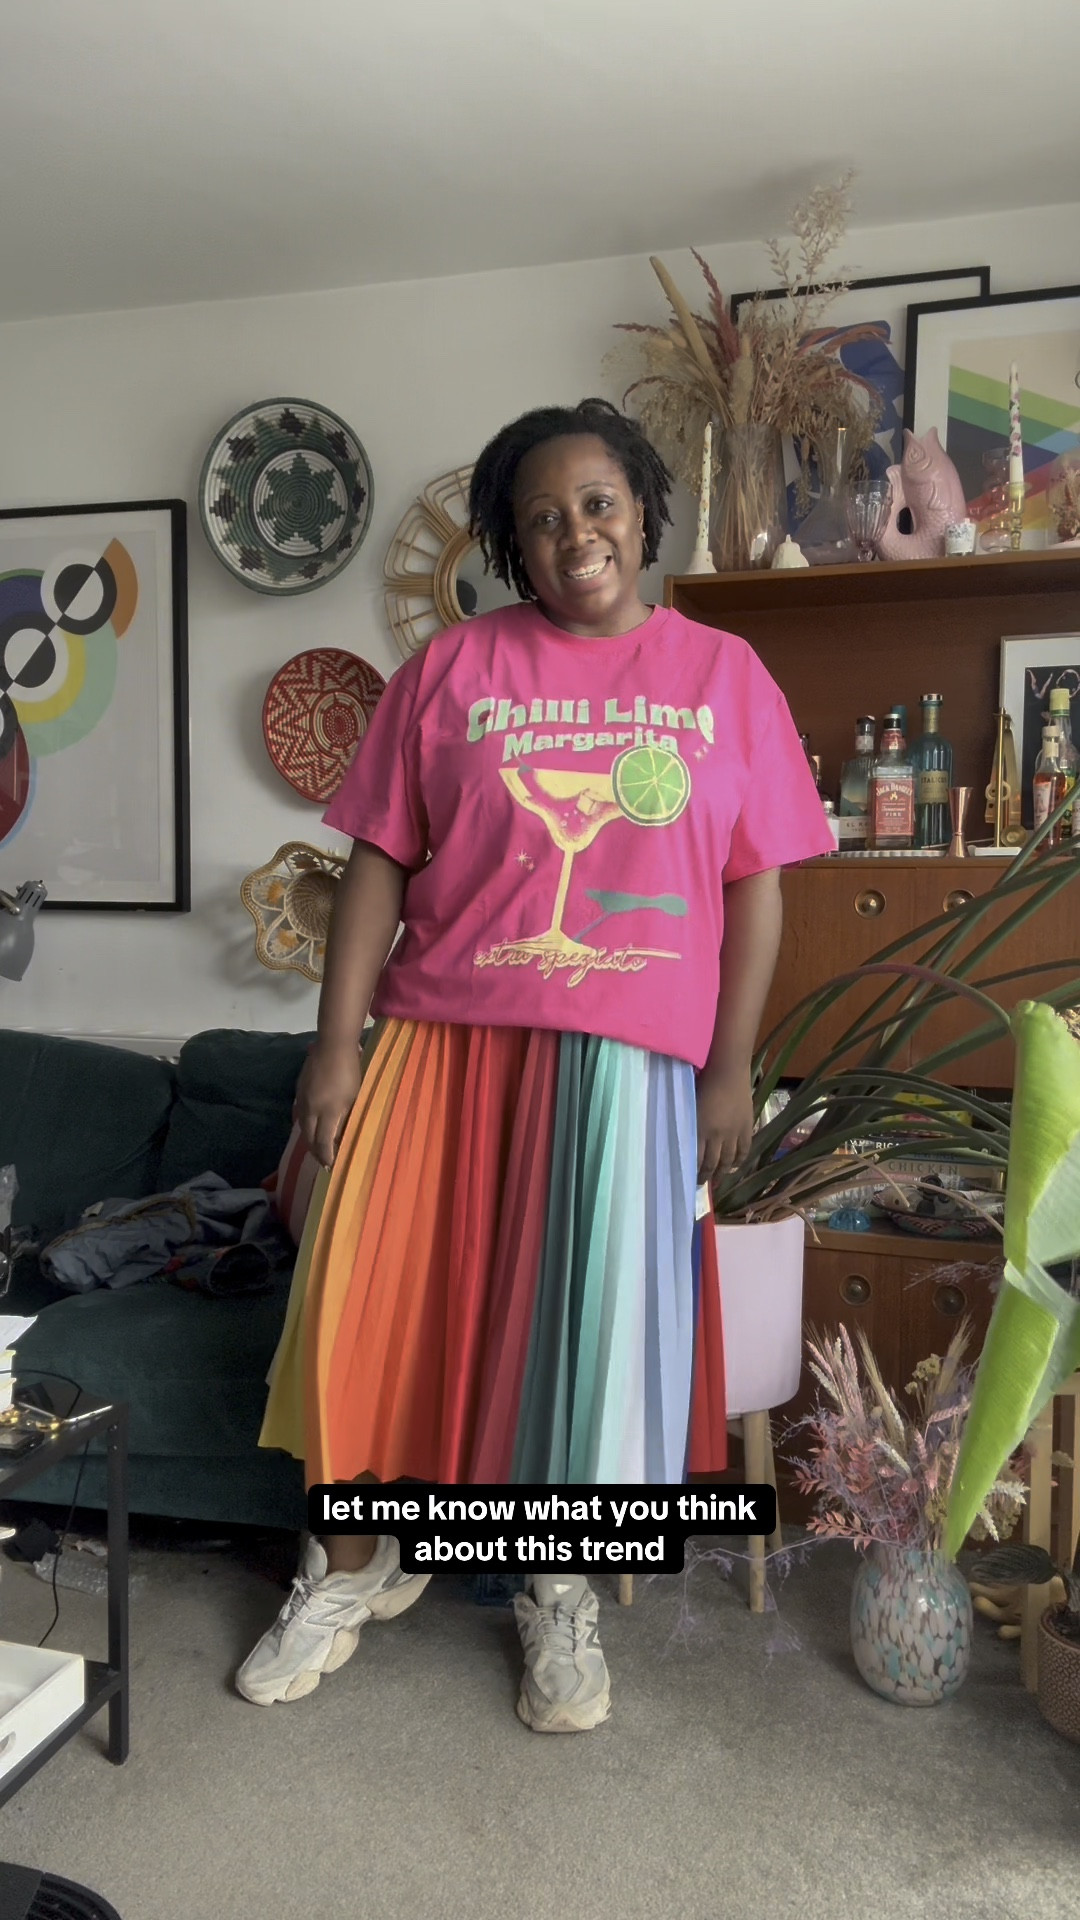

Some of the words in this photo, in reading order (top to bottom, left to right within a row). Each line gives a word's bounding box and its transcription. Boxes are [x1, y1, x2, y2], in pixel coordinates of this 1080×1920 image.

[466, 696, 590, 742] Chilli
[502, 726, 679, 763] Margarita
[888, 1160, 959, 1176] CHICKEN
